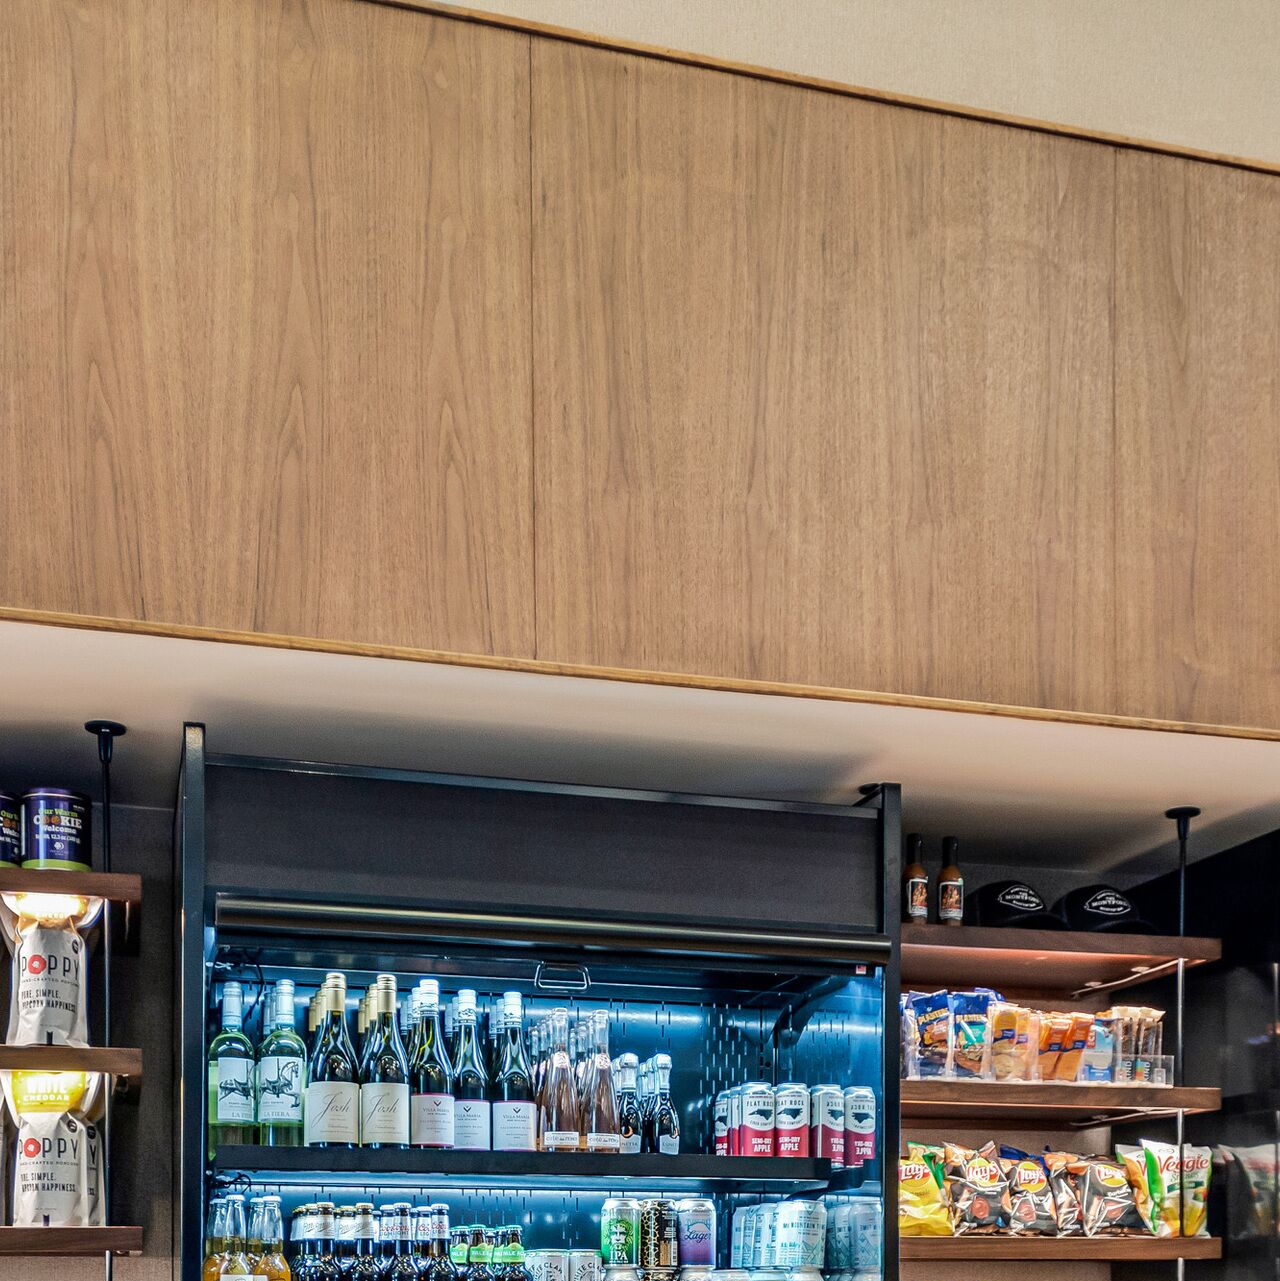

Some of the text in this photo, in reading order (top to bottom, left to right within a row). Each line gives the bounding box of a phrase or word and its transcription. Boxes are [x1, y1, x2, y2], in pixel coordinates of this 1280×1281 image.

[33, 815, 82, 829] COOKIE
[22, 954, 79, 981] POPPY
[27, 1076, 67, 1095] WHITE
[312, 1091, 352, 1128] Josh
[362, 1092, 399, 1126] Josh
[780, 1143, 798, 1151] APPLE
[610, 1251, 628, 1260] IPA
